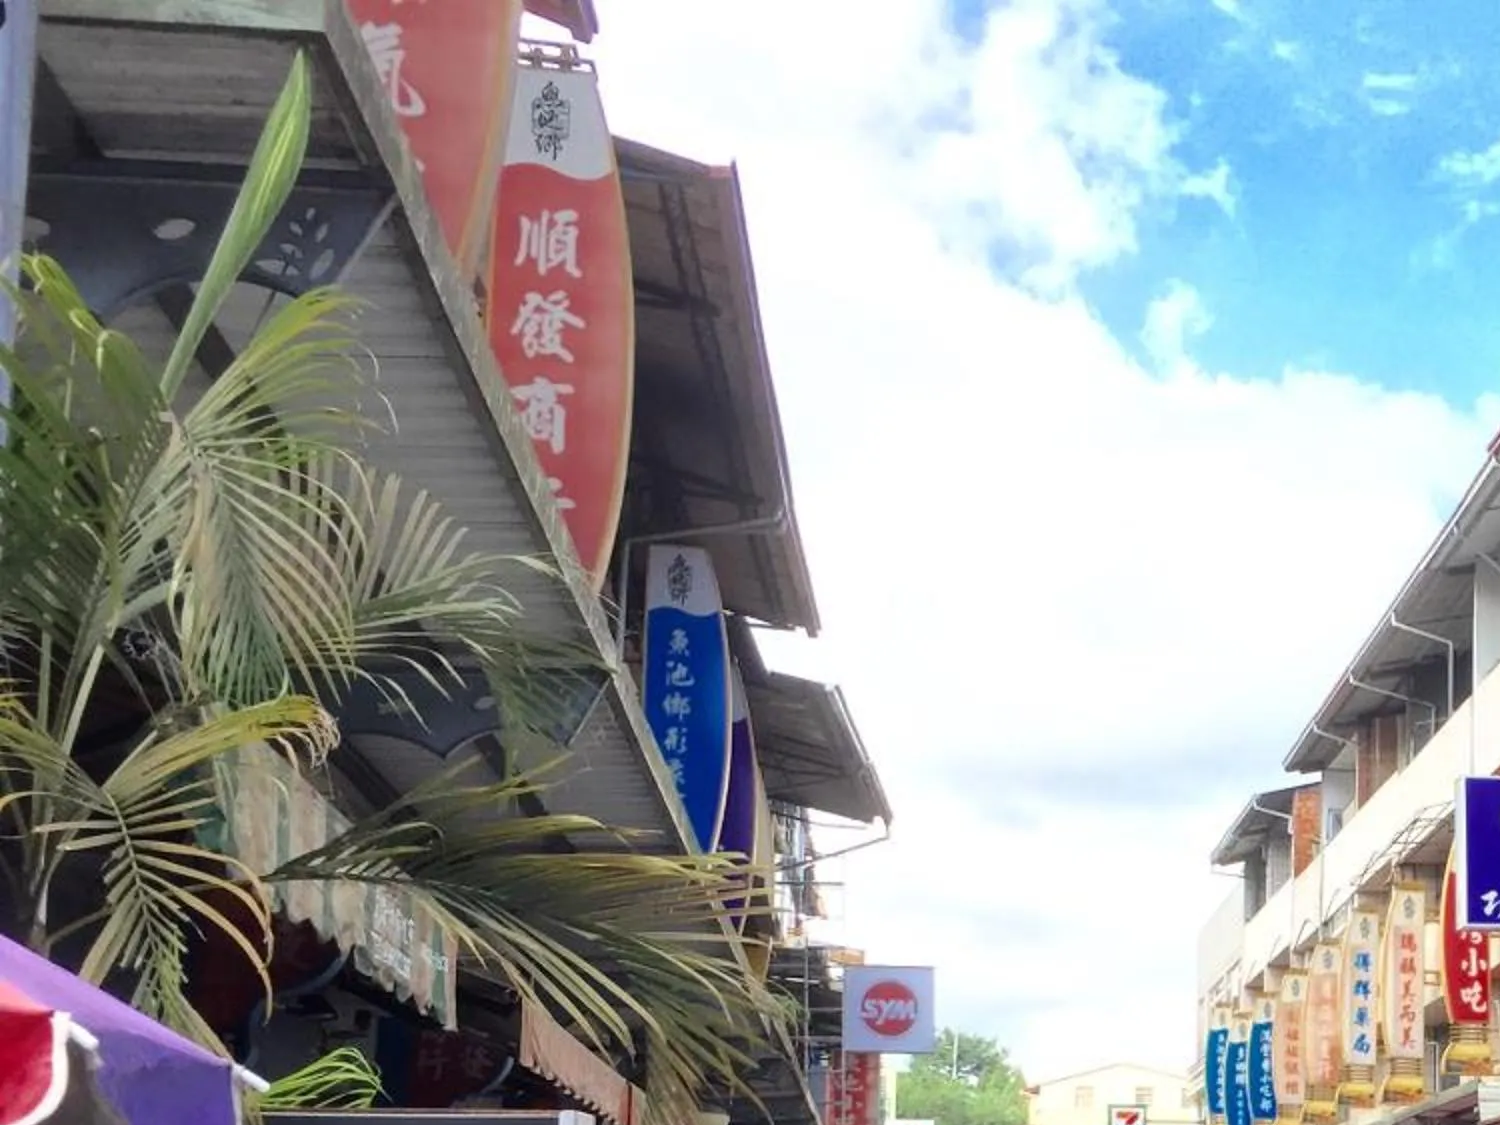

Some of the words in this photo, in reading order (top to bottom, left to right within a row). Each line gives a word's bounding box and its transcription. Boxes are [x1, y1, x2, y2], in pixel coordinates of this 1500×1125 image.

[662, 628, 694, 803] 魚池鄉形象
[861, 997, 917, 1024] SYM
